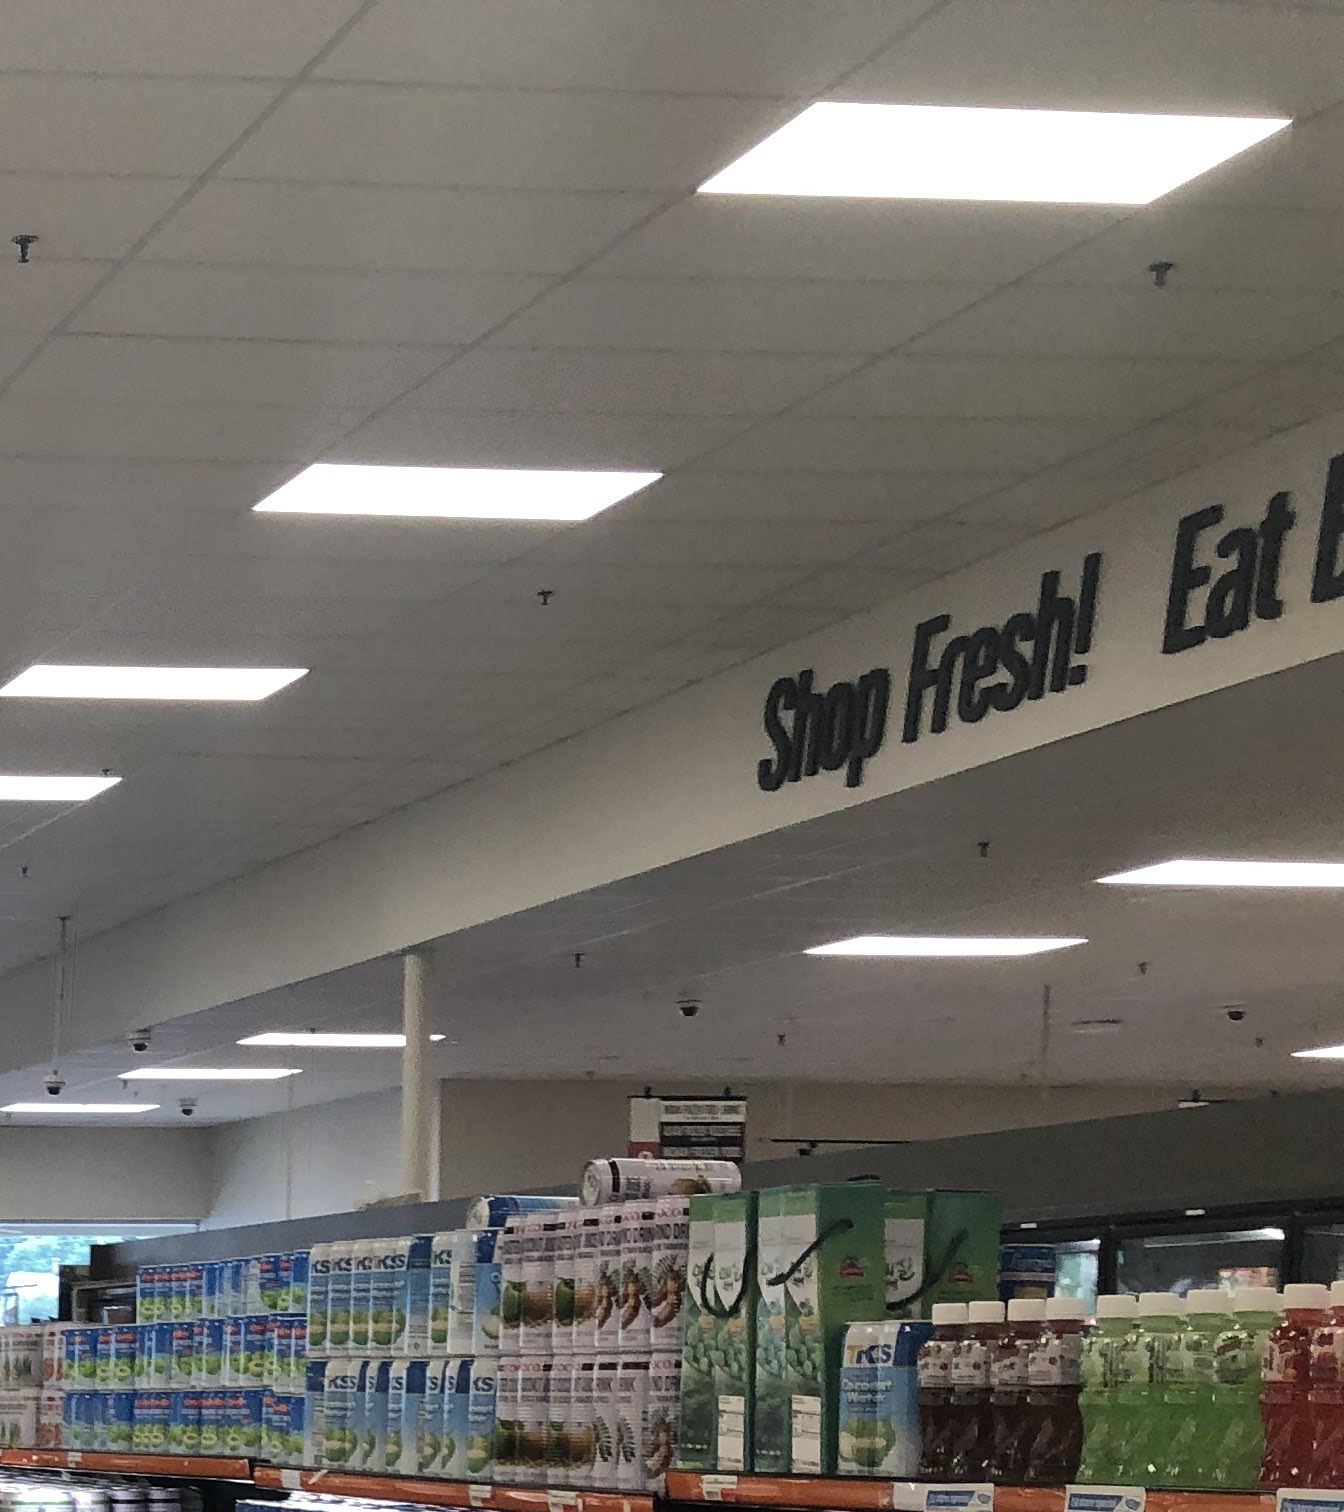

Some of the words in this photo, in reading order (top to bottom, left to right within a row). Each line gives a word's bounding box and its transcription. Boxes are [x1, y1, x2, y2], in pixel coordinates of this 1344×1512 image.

[758, 668, 891, 792] Shop
[902, 551, 1104, 744] Fresh!
[1161, 489, 1296, 655] Eat
